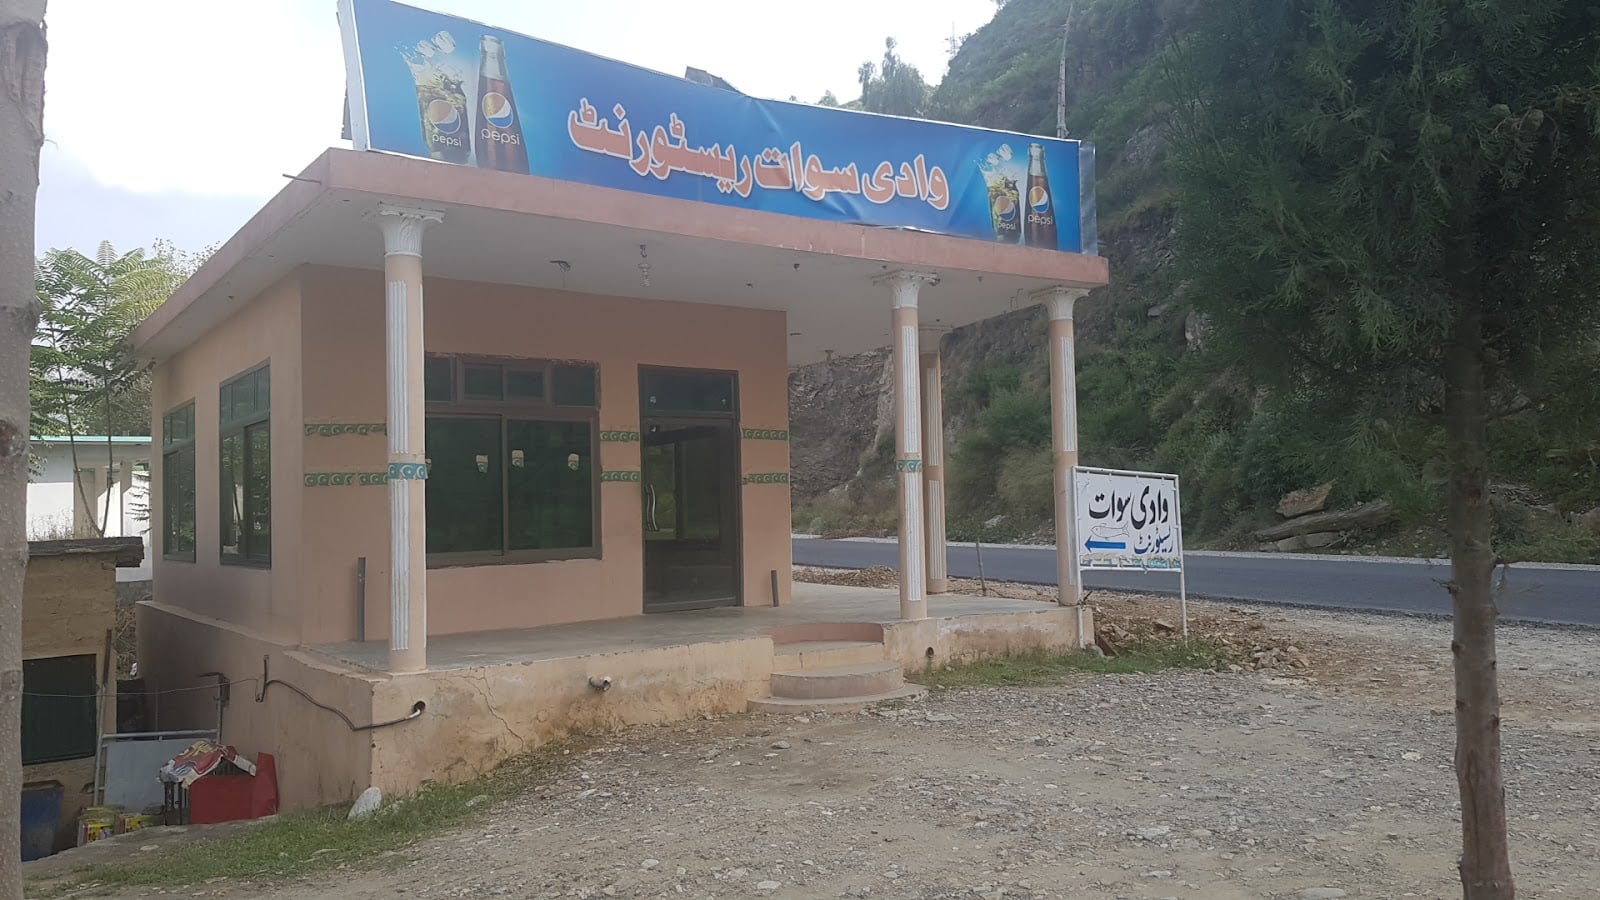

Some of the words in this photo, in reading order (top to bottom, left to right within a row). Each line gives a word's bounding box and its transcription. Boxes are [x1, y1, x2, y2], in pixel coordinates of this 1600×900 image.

[432, 133, 462, 147] pepsi
[481, 128, 520, 145] pepsi
[568, 97, 752, 198] ریسٹورنٹ
[754, 141, 860, 201] سوات
[861, 153, 950, 210] وادی
[997, 222, 1016, 231] pepsi
[1027, 214, 1053, 225] pepsi
[1088, 489, 1132, 522] سوات
[1130, 485, 1169, 530] وادی
